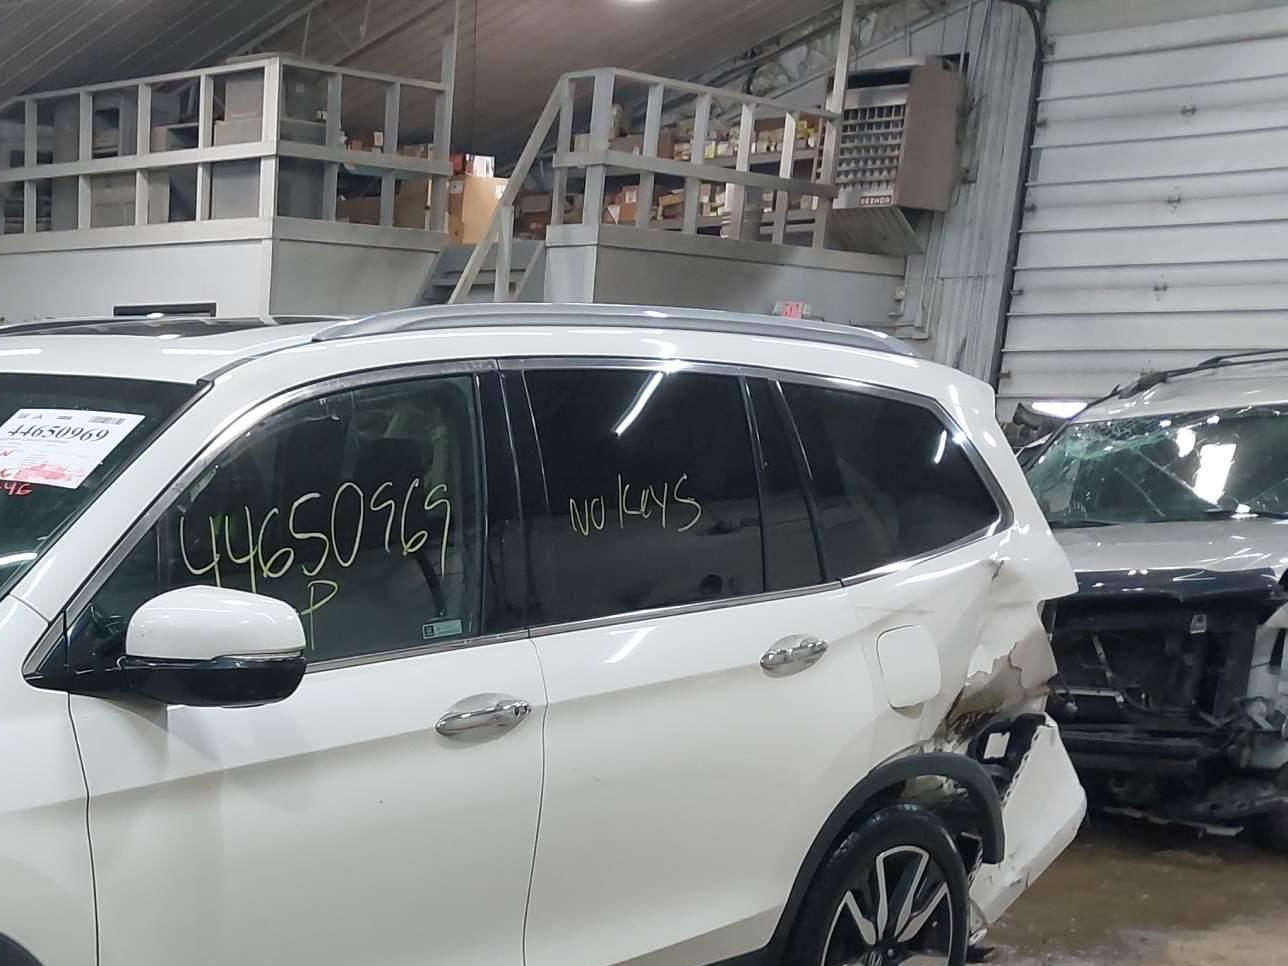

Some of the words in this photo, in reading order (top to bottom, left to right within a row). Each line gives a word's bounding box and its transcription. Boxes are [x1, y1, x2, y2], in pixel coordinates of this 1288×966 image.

[8, 424, 110, 442] 44650969
[180, 478, 452, 593] 44650969
[569, 496, 605, 536] NO
